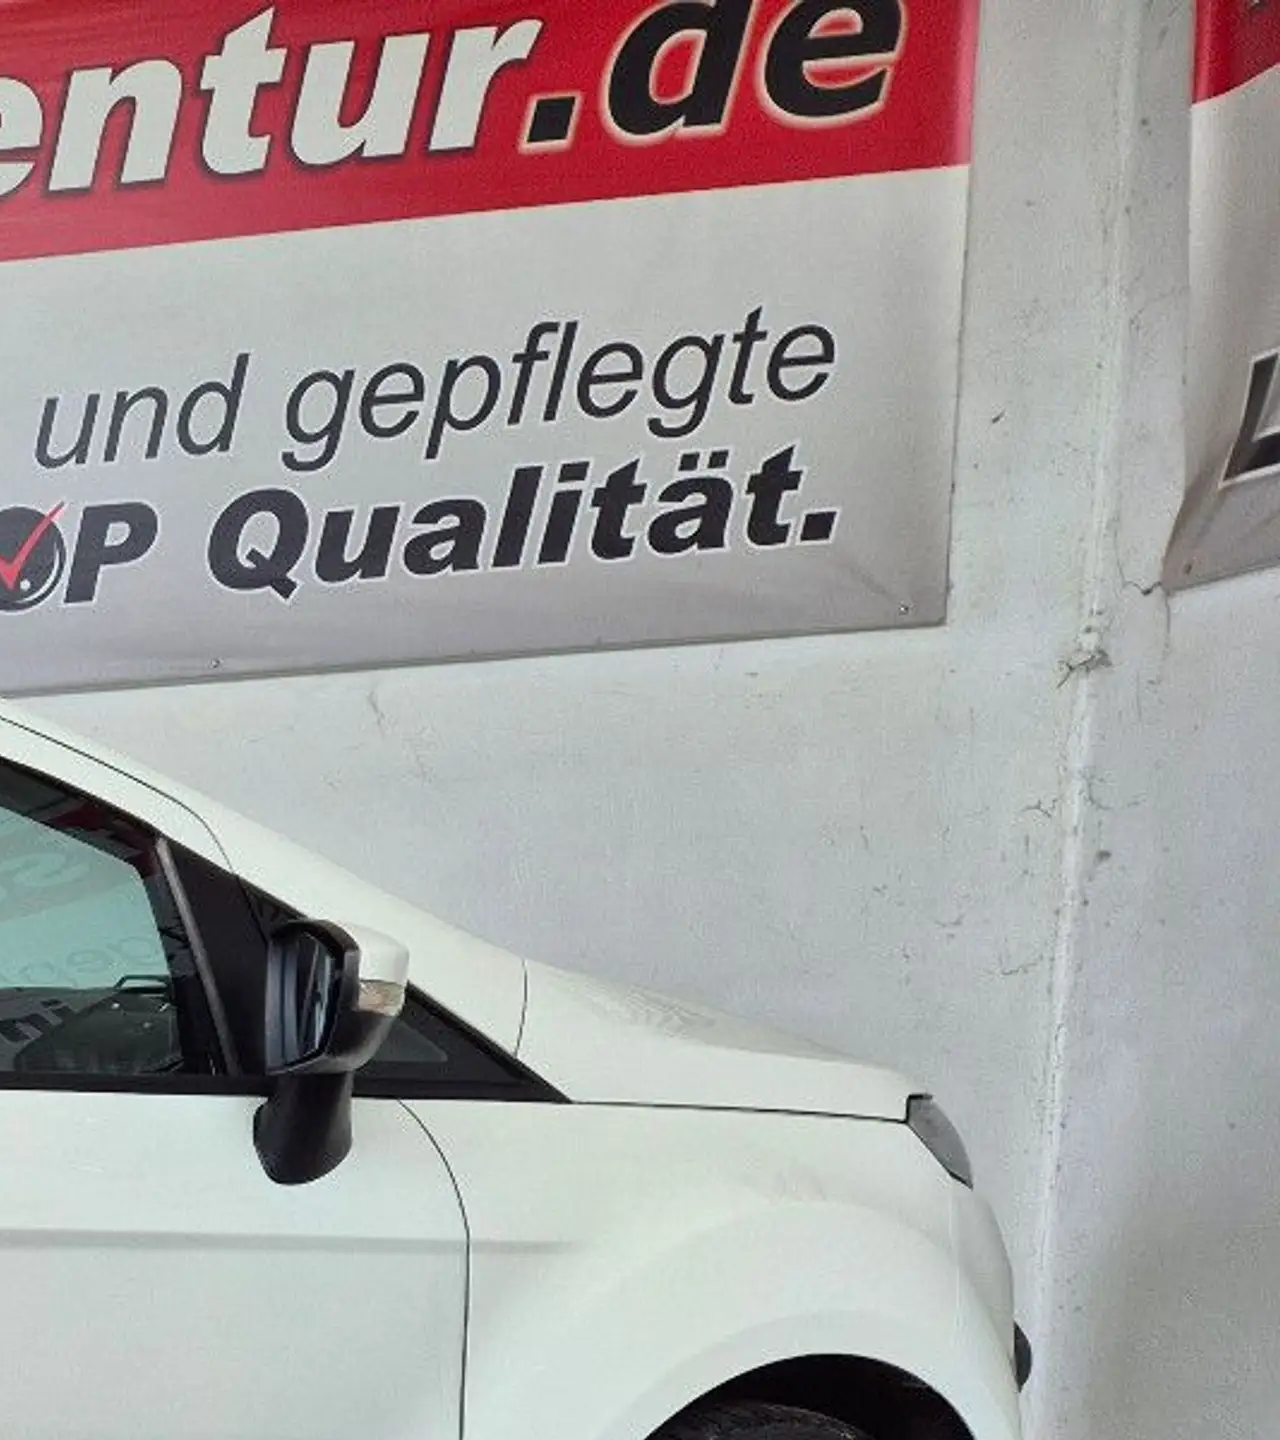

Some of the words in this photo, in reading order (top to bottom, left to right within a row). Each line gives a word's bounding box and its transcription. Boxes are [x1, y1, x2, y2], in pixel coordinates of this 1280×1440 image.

[36, 354, 250, 470] und
[280, 306, 835, 472] gepflegte
[206, 445, 837, 599] Qualität.
